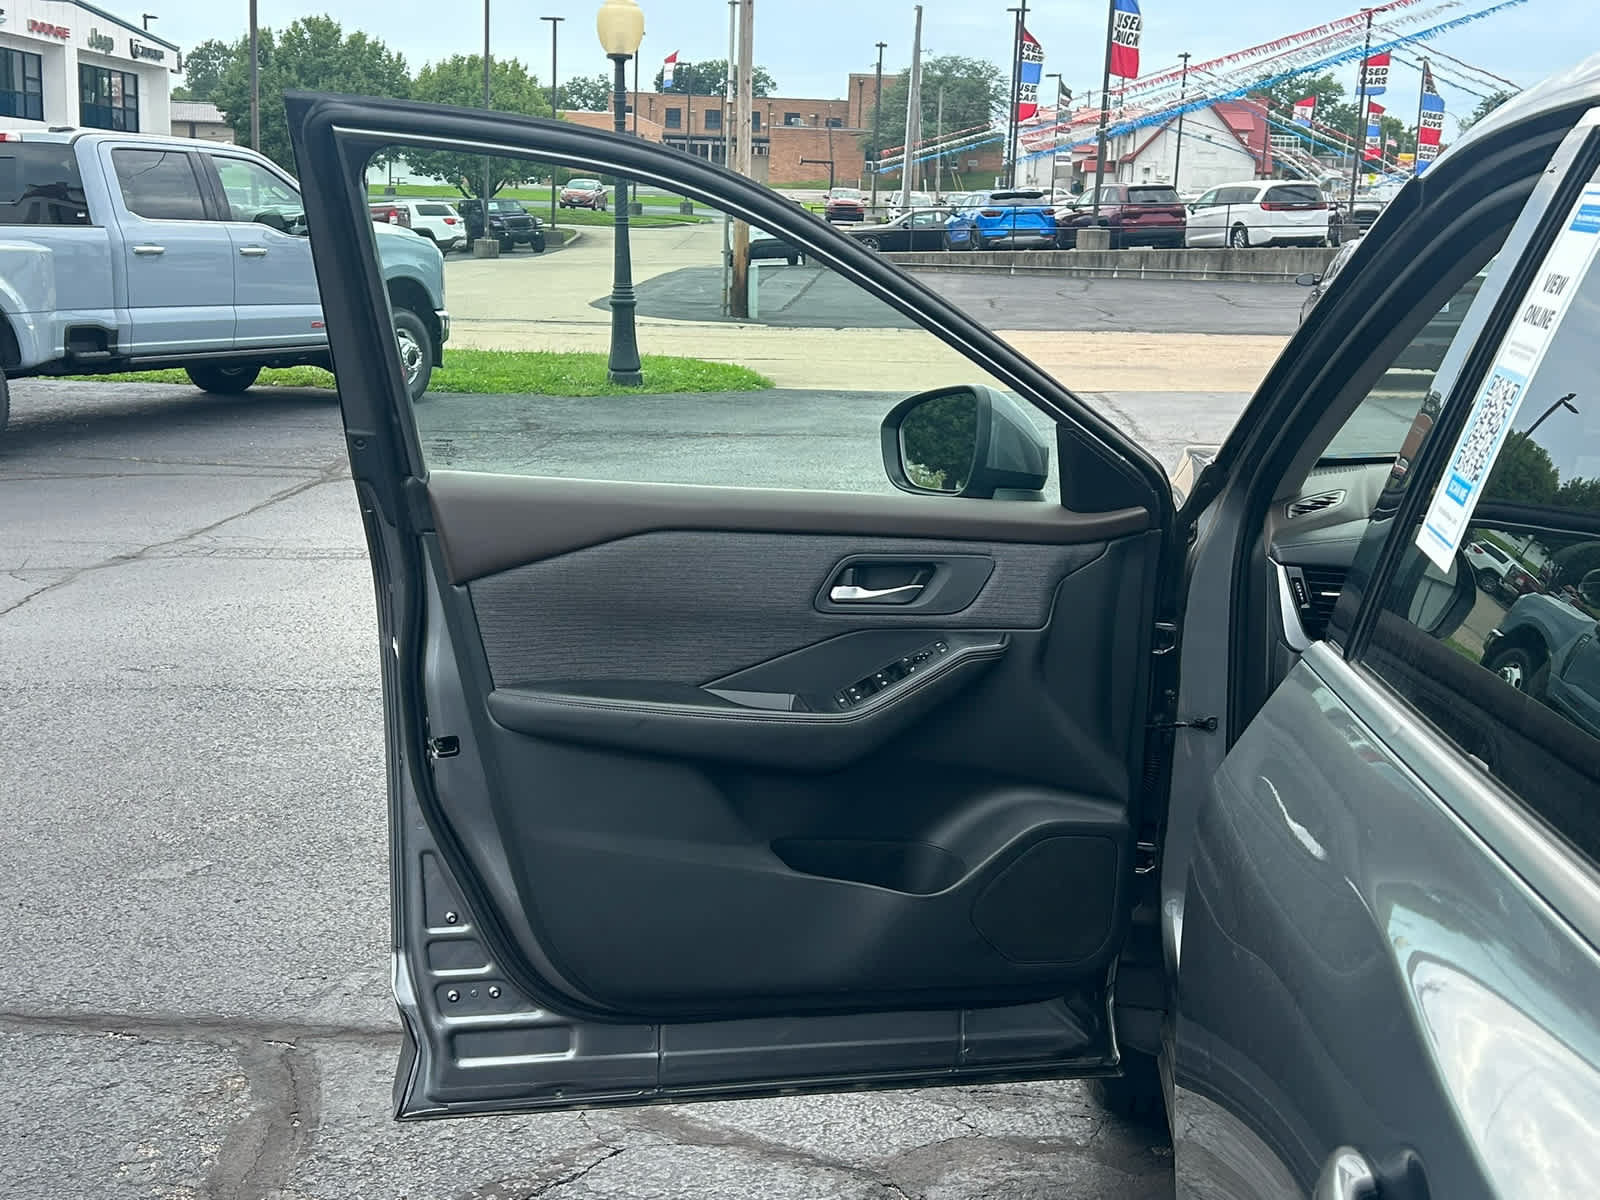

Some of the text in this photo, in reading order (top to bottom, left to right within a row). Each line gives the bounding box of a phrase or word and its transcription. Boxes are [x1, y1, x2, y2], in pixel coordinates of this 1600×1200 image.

[1422, 111, 1444, 120] USED
[1543, 272, 1570, 296] VIEW
[1523, 304, 1556, 330] ONLINE
